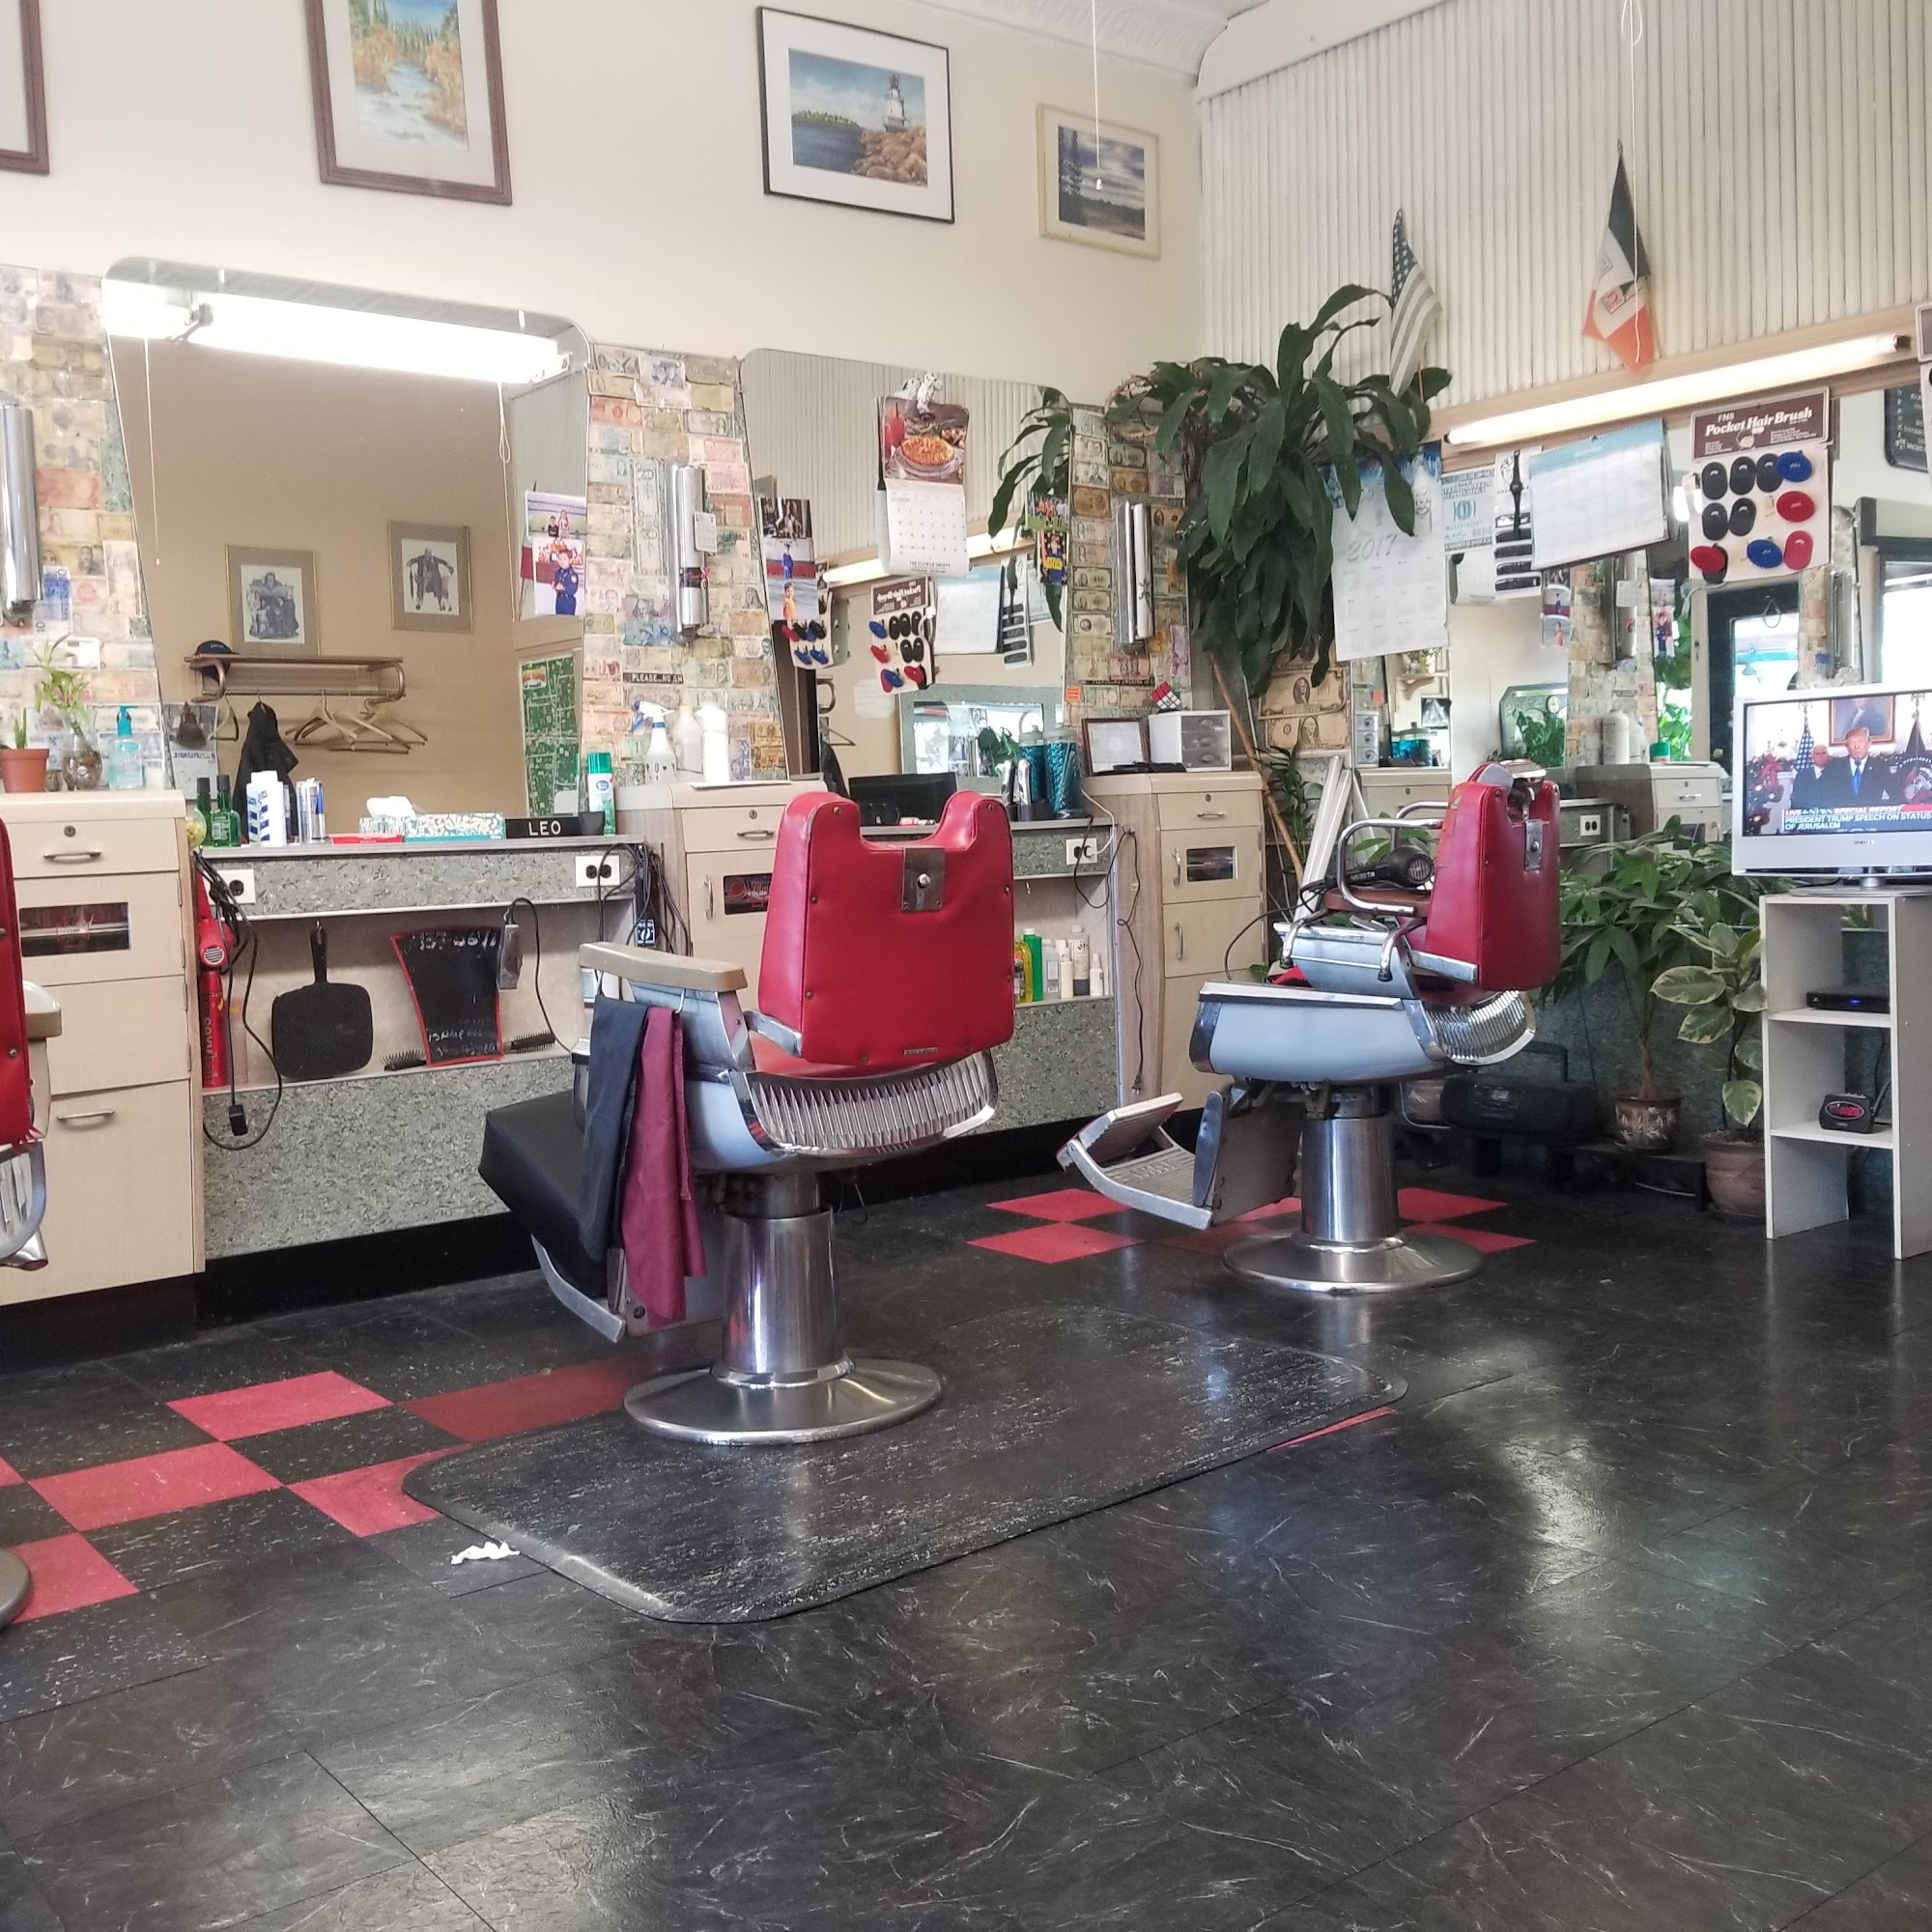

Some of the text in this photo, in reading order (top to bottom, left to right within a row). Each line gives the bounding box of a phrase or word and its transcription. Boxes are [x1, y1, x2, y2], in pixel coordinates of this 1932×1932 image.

[1705, 420, 1746, 437] Pocket
[1747, 413, 1775, 430] Hair
[1775, 407, 1812, 424] Brush
[1347, 533, 1398, 562] 2017
[528, 820, 562, 837] LEO
[1828, 814, 1854, 823] TRUMP
